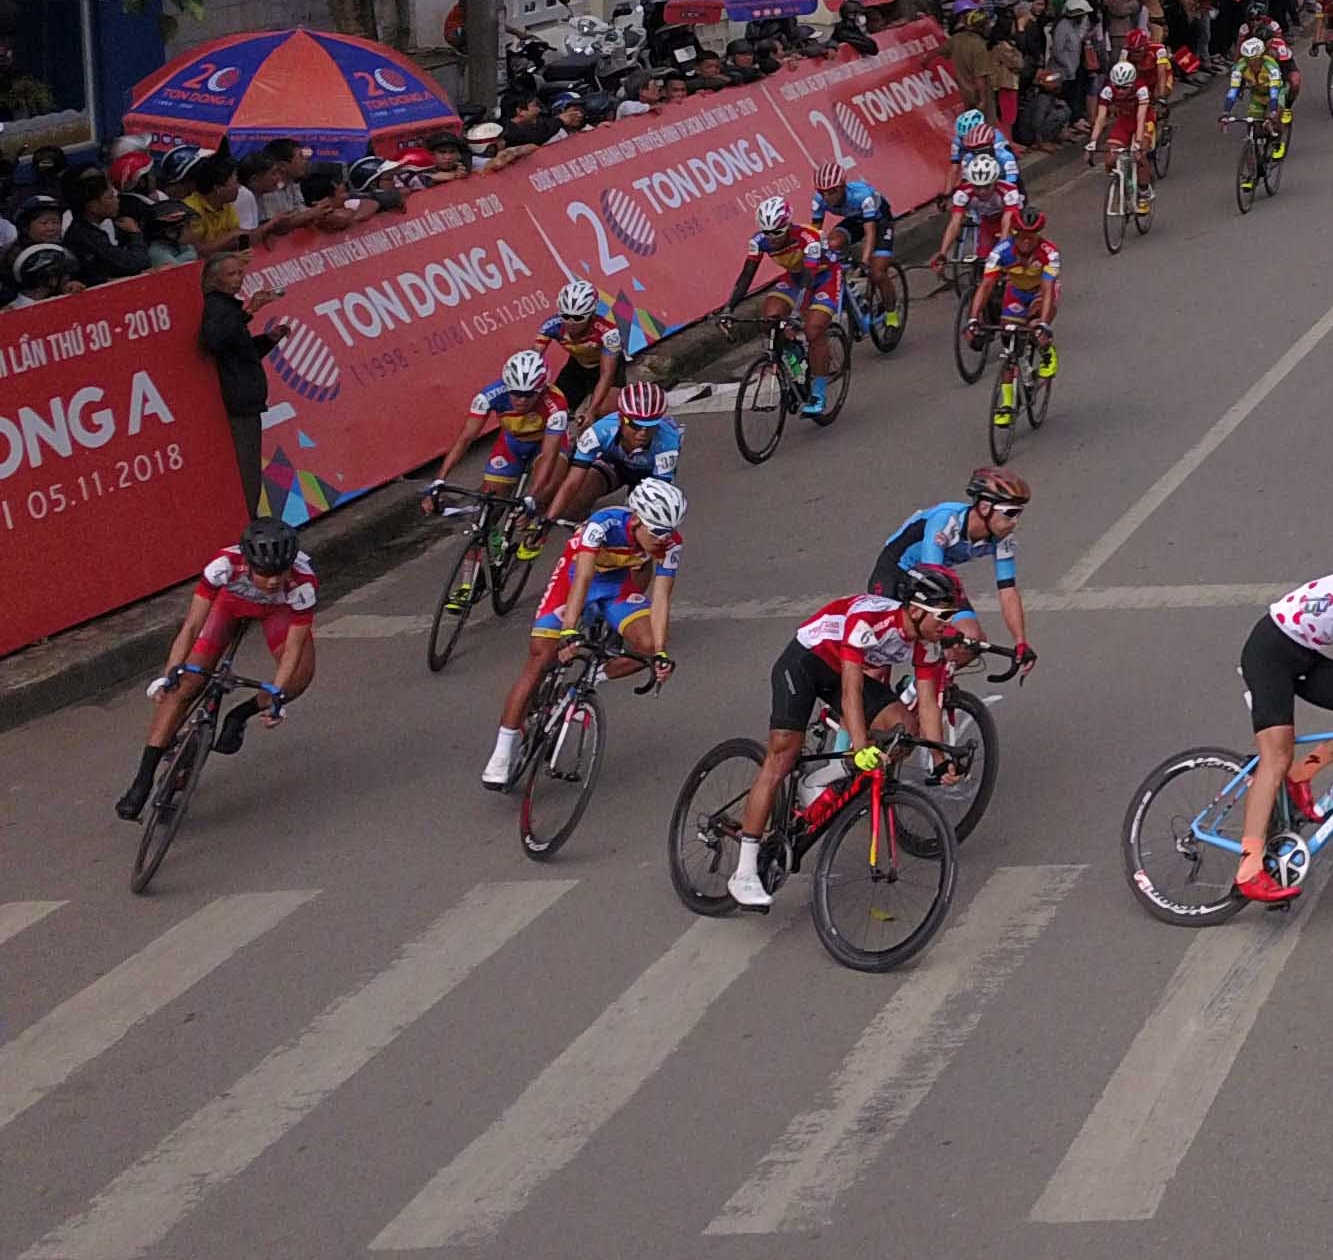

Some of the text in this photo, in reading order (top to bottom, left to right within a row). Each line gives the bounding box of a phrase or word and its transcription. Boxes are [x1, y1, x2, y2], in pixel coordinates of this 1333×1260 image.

[852, 86, 900, 126] TON
[890, 70, 945, 112] DONG
[936, 65, 959, 94] A
[632, 162, 698, 215] TON
[687, 139, 764, 196] DONG
[754, 133, 785, 171] A
[314, 238, 532, 347] TON DONG A
[472, 290, 550, 336] 05.11.2018
[8, 333, 48, 374] LẦN
[46, 322, 86, 362] THỨ
[86, 320, 113, 352] 30
[124, 303, 171, 341] 2018
[128, 370, 176, 436] A
[27, 443, 184, 520] 05.11.2018
